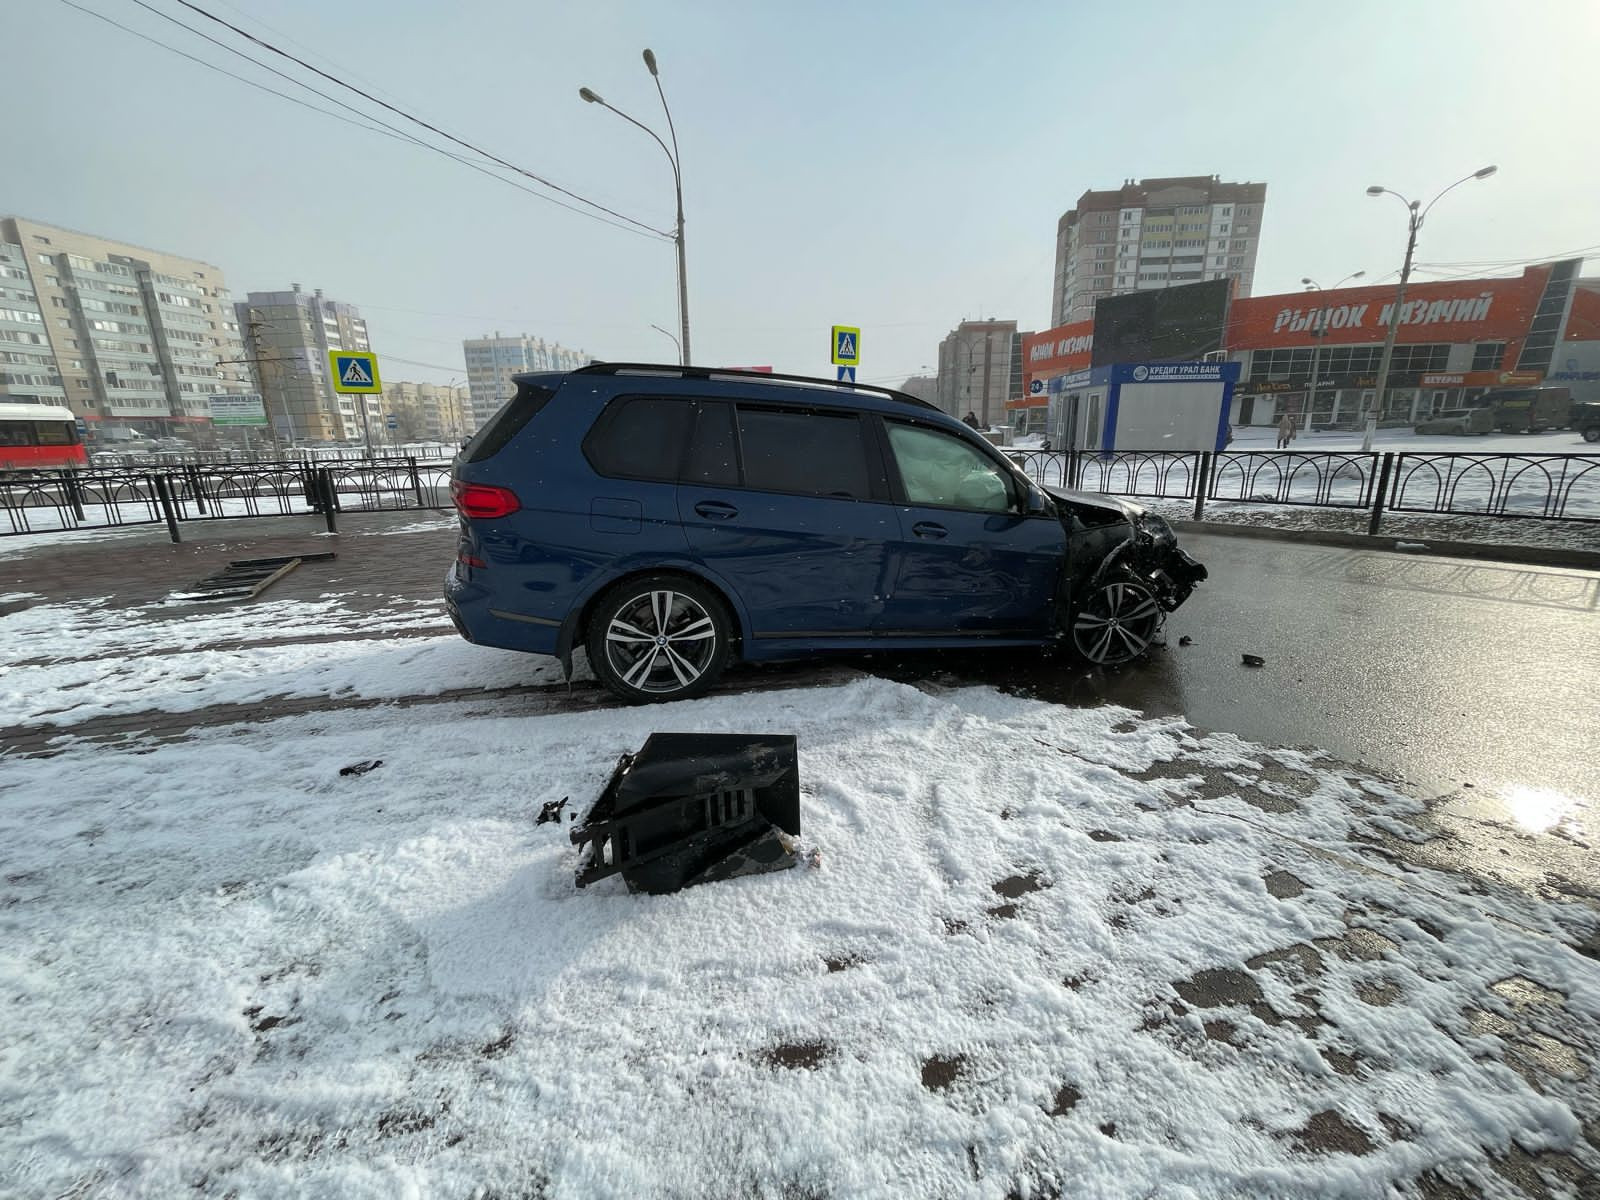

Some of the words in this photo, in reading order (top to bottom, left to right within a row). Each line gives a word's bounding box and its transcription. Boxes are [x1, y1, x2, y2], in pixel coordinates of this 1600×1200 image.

[1273, 303, 1369, 333] РЫНОК
[1376, 291, 1495, 327] КАЗАЧИЙ
[1149, 366, 1178, 375] КРЕДИТ
[1179, 365, 1199, 374] УРАЛ
[1200, 365, 1221, 374] БАНК
